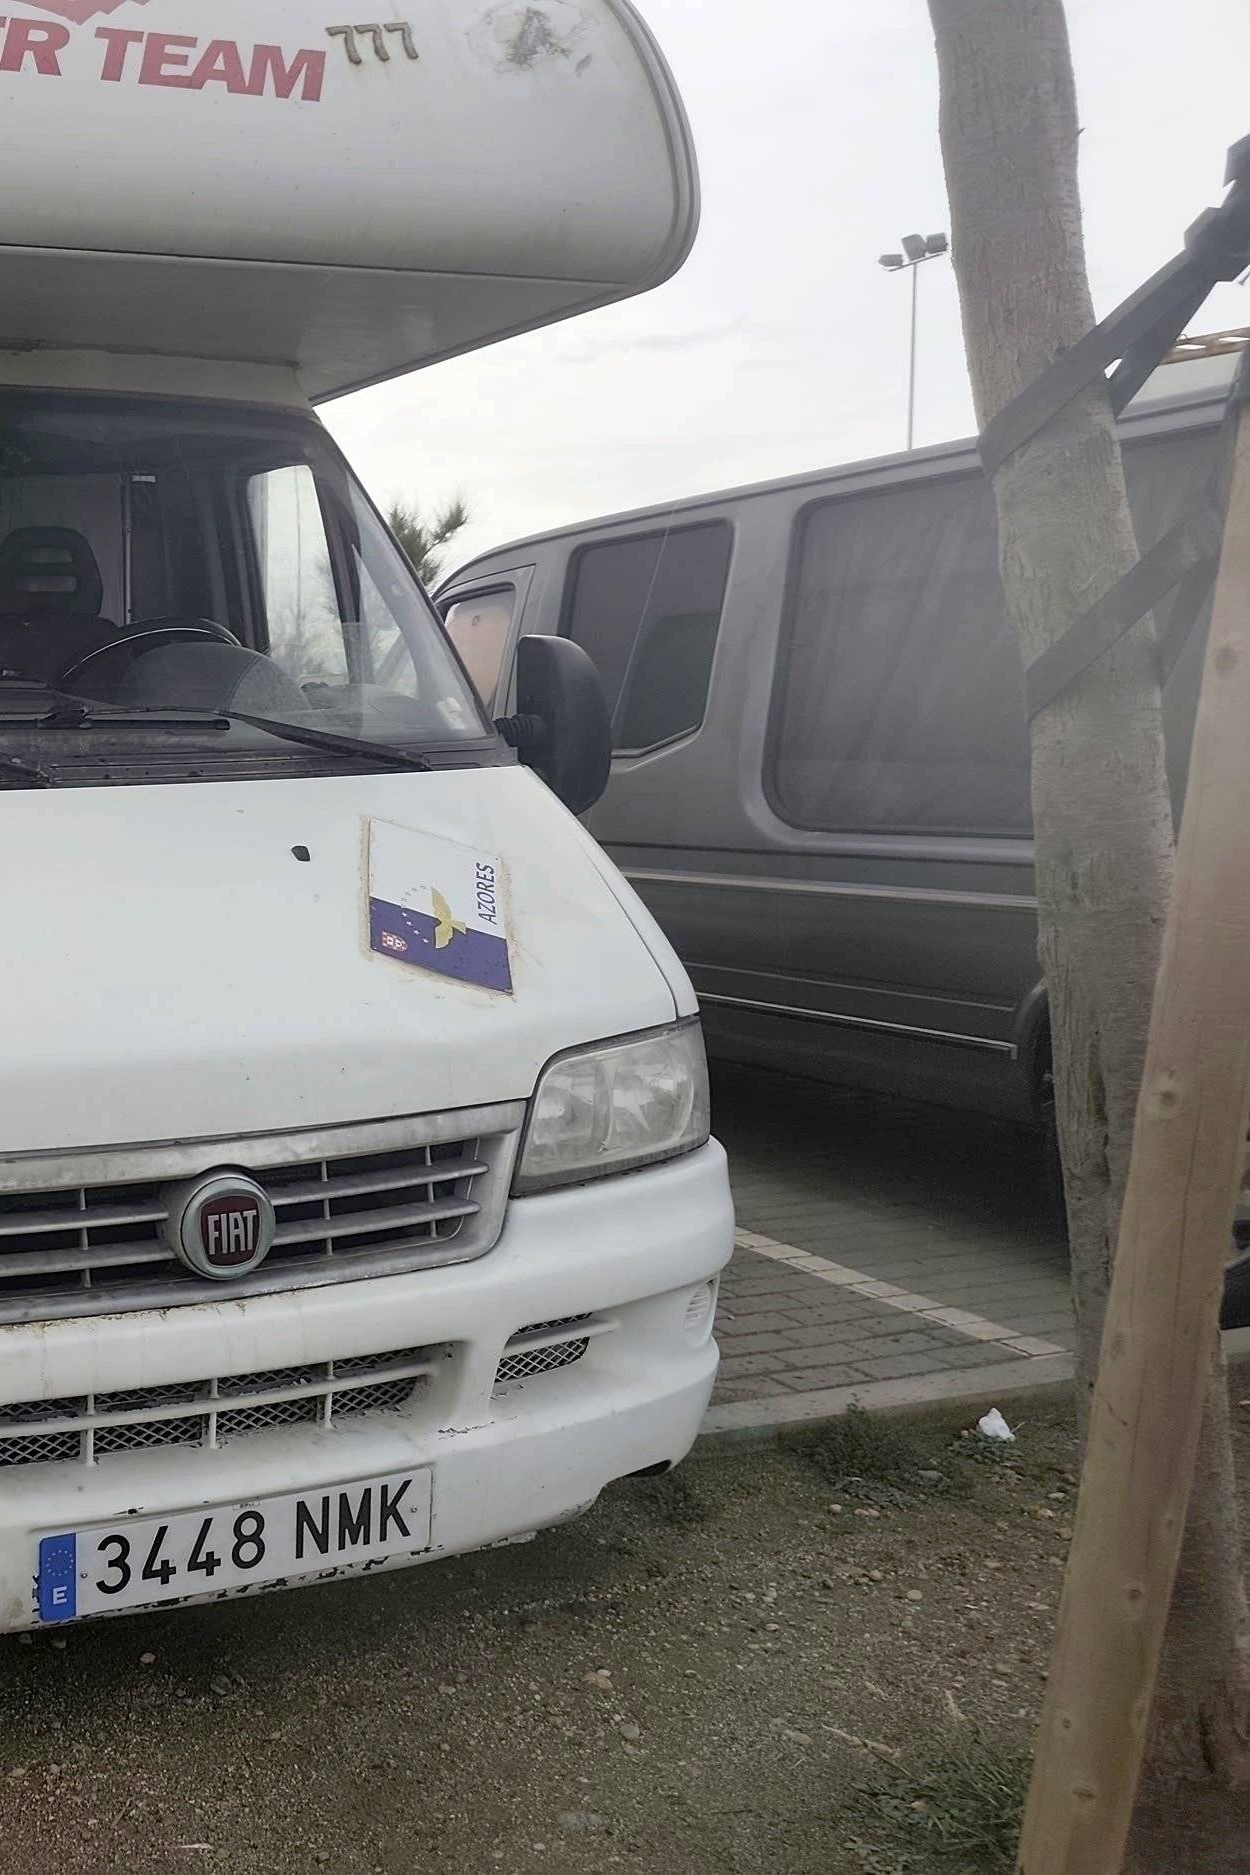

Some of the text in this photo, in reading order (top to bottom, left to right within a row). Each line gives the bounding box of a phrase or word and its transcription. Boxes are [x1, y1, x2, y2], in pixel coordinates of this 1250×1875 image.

[94, 26, 327, 102] TEAM
[325, 22, 419, 65] 777
[475, 861, 498, 925] AZORES
[207, 1209, 257, 1256] FIAT
[95, 1479, 413, 1595] 3448 NMK
[52, 1586, 67, 1605] E
